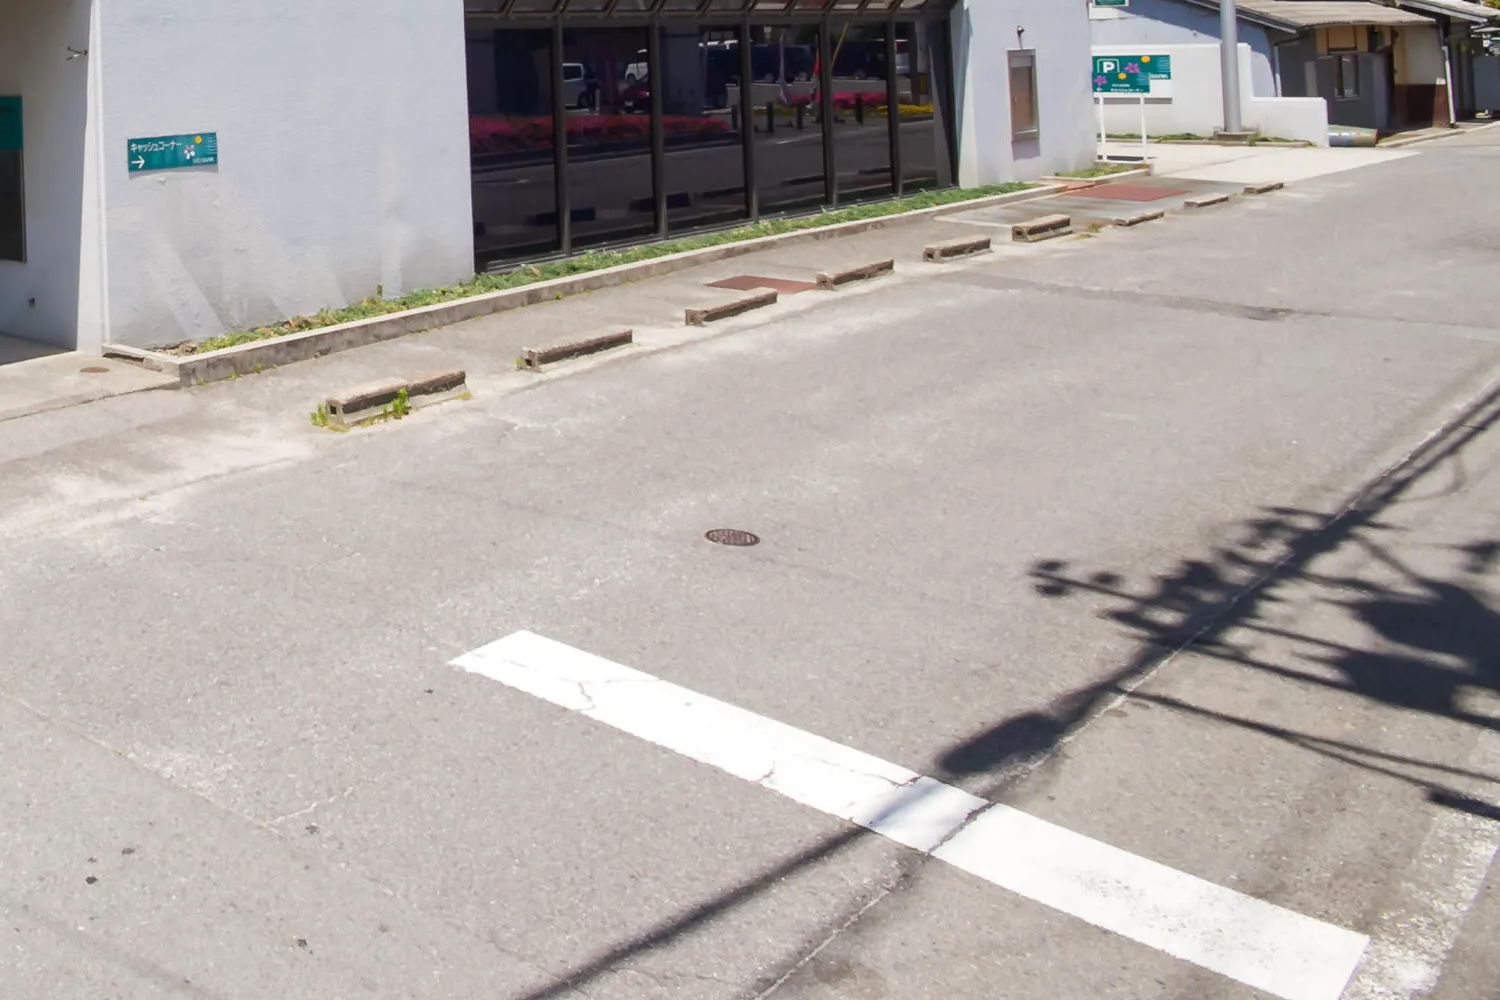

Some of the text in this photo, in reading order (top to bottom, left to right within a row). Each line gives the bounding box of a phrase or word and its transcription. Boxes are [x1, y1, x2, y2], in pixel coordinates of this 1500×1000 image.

[1102, 61, 1115, 74] P
[130, 140, 182, 153] キャッシュコーナー
